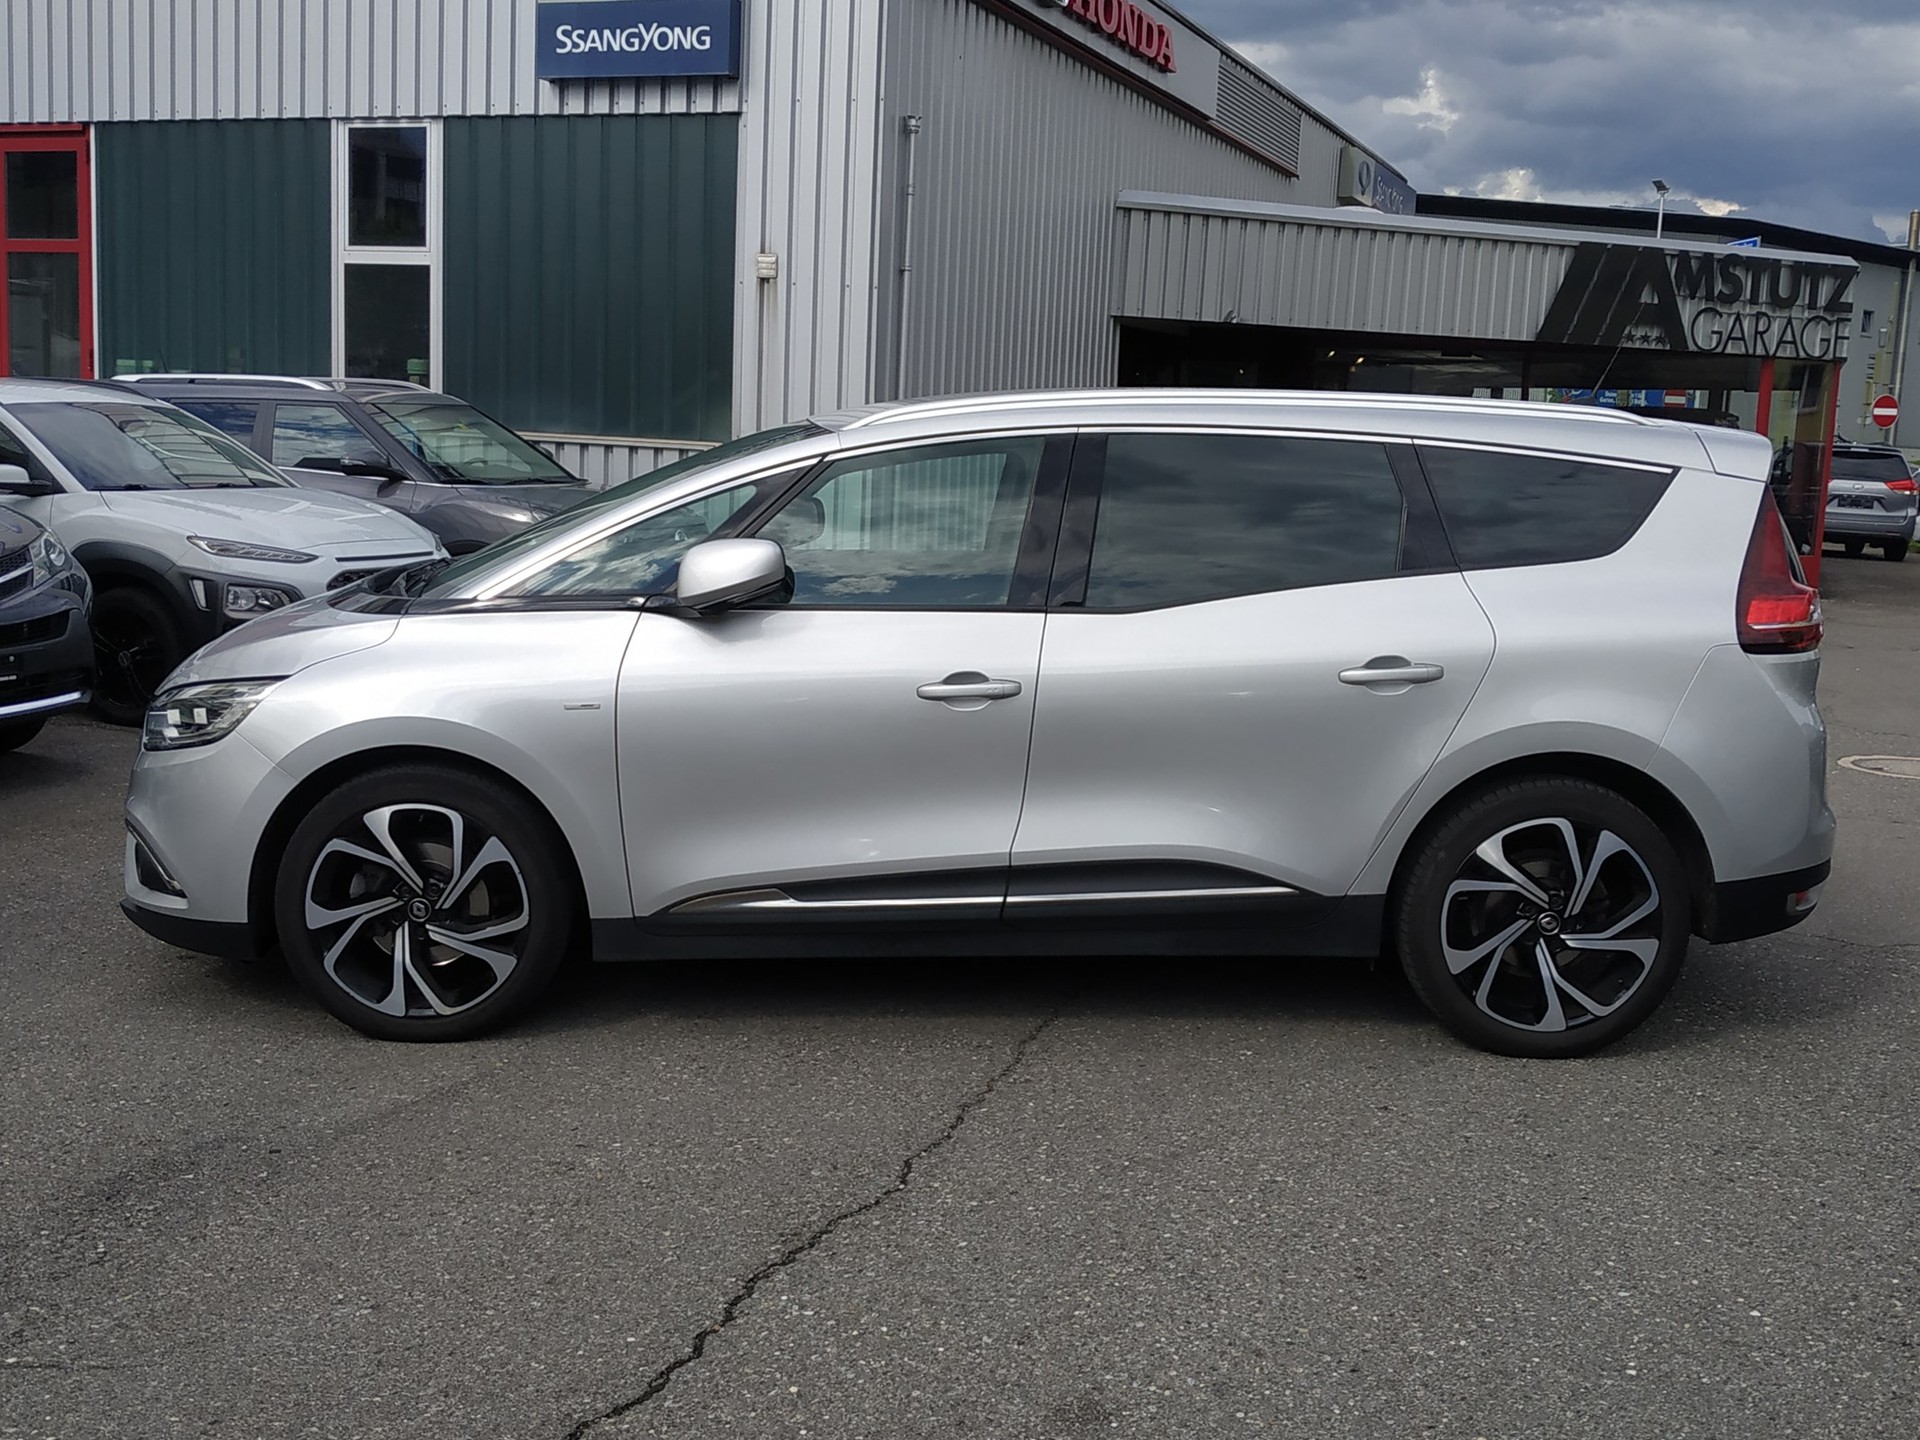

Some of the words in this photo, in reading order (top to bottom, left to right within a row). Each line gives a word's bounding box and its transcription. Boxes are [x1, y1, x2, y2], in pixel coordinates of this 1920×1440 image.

[1067, 0, 1177, 73] HONDA
[1590, 247, 1859, 349] AMSTUTZ
[1690, 306, 1852, 361] GARAGE
